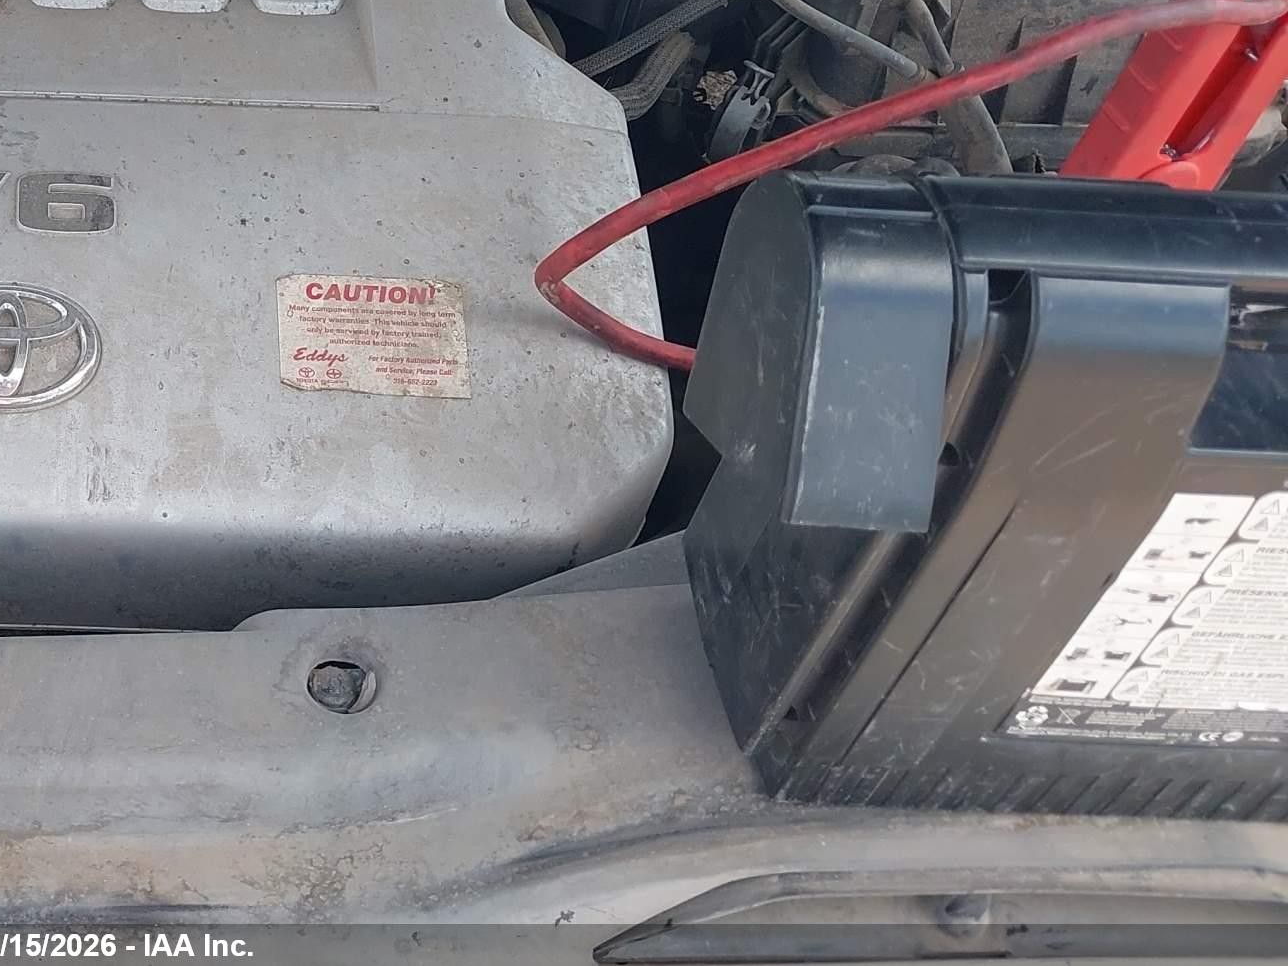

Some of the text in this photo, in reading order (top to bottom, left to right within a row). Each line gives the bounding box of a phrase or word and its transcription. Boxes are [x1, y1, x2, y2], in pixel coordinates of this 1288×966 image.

[288, 304, 309, 312] Many
[312, 306, 359, 314] components
[408, 309, 417, 317] by
[419, 309, 436, 318] long
[299, 315, 326, 324] factory
[374, 318, 390, 326] This
[391, 319, 419, 327] vehicle
[421, 320, 447, 328] should
[306, 327, 323, 335] only
[371, 329, 380, 338] by
[382, 330, 409, 339] factory
[329, 338, 371, 346] authorized
[380, 355, 404, 363] Factory
[416, 367, 438, 375] Please
